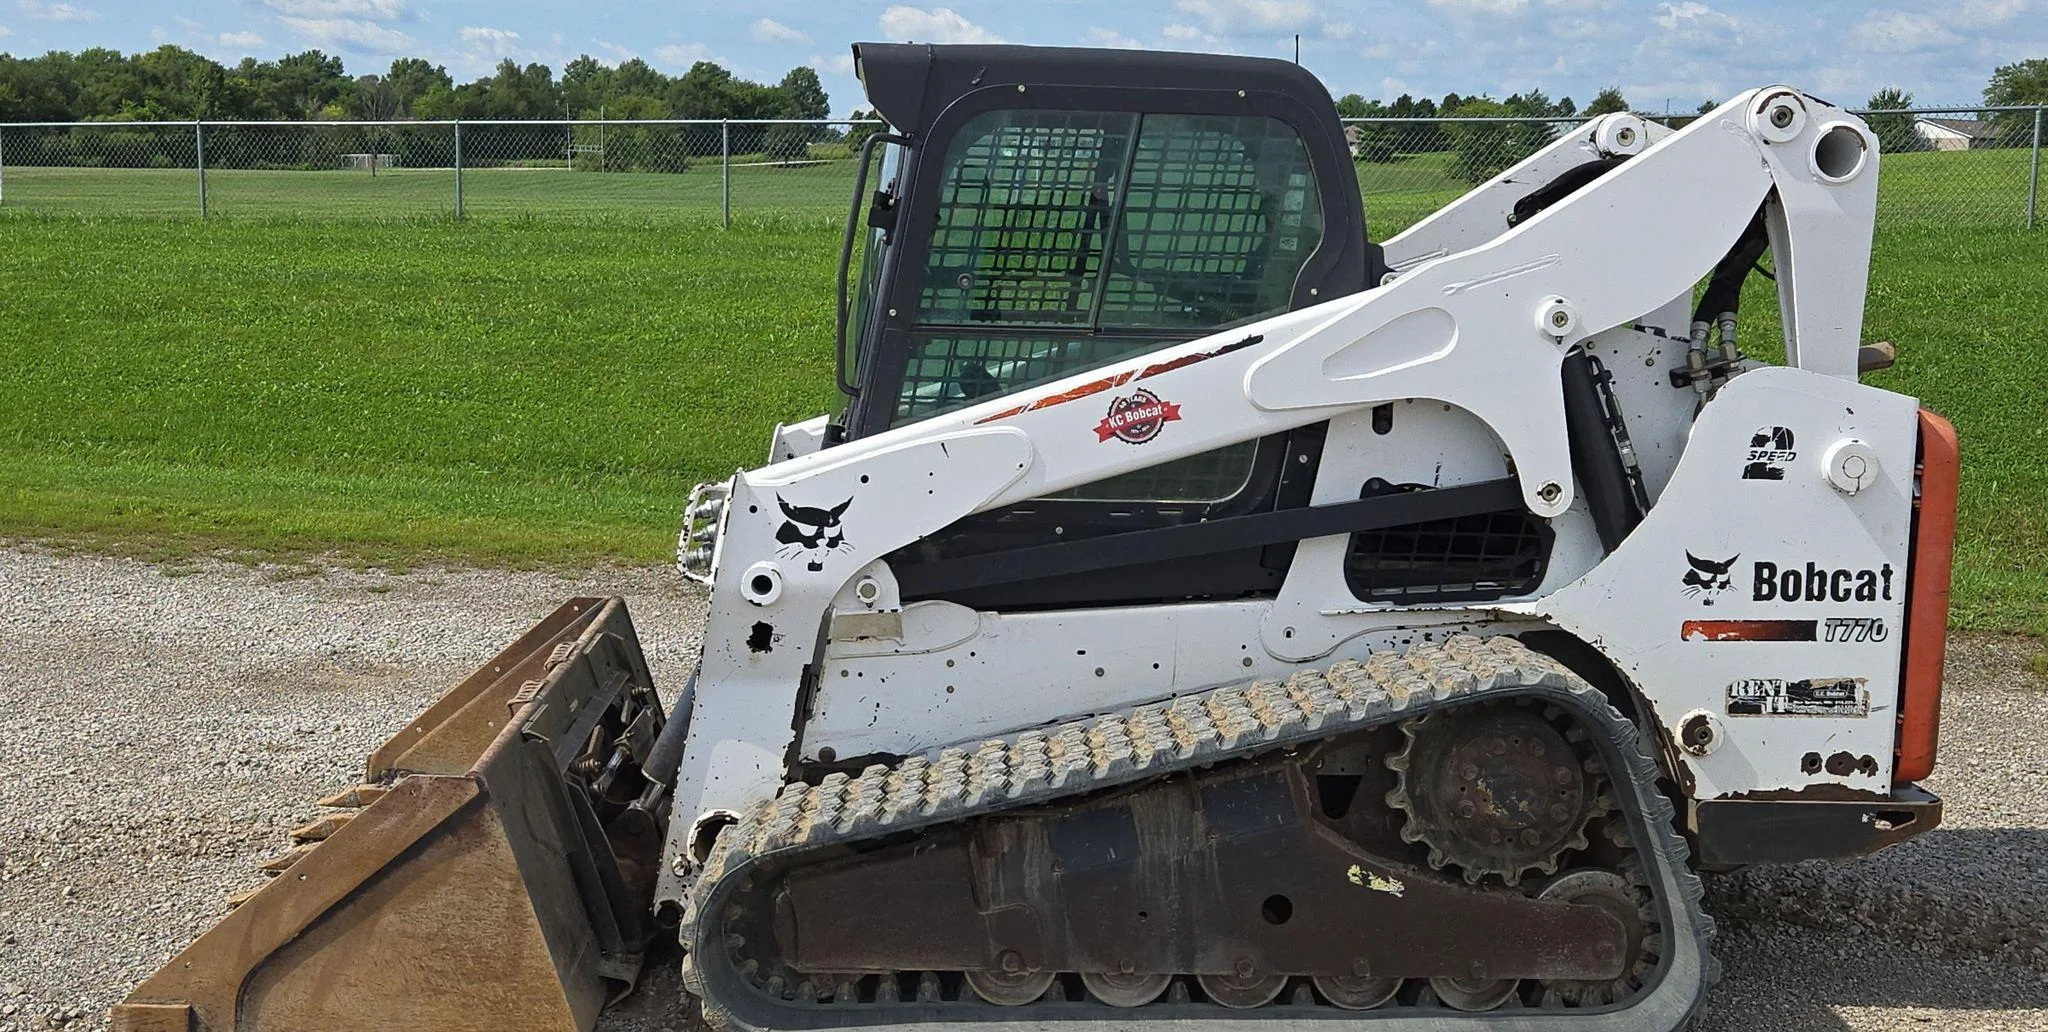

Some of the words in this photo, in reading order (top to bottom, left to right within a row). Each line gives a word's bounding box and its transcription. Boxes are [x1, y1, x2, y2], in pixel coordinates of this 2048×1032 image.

[1109, 414, 1124, 428] KC
[1125, 404, 1163, 422] Bobcat
[1746, 450, 1797, 462] SPEED
[1752, 561, 1894, 602] Bobcat
[1825, 617, 1888, 643] T770
